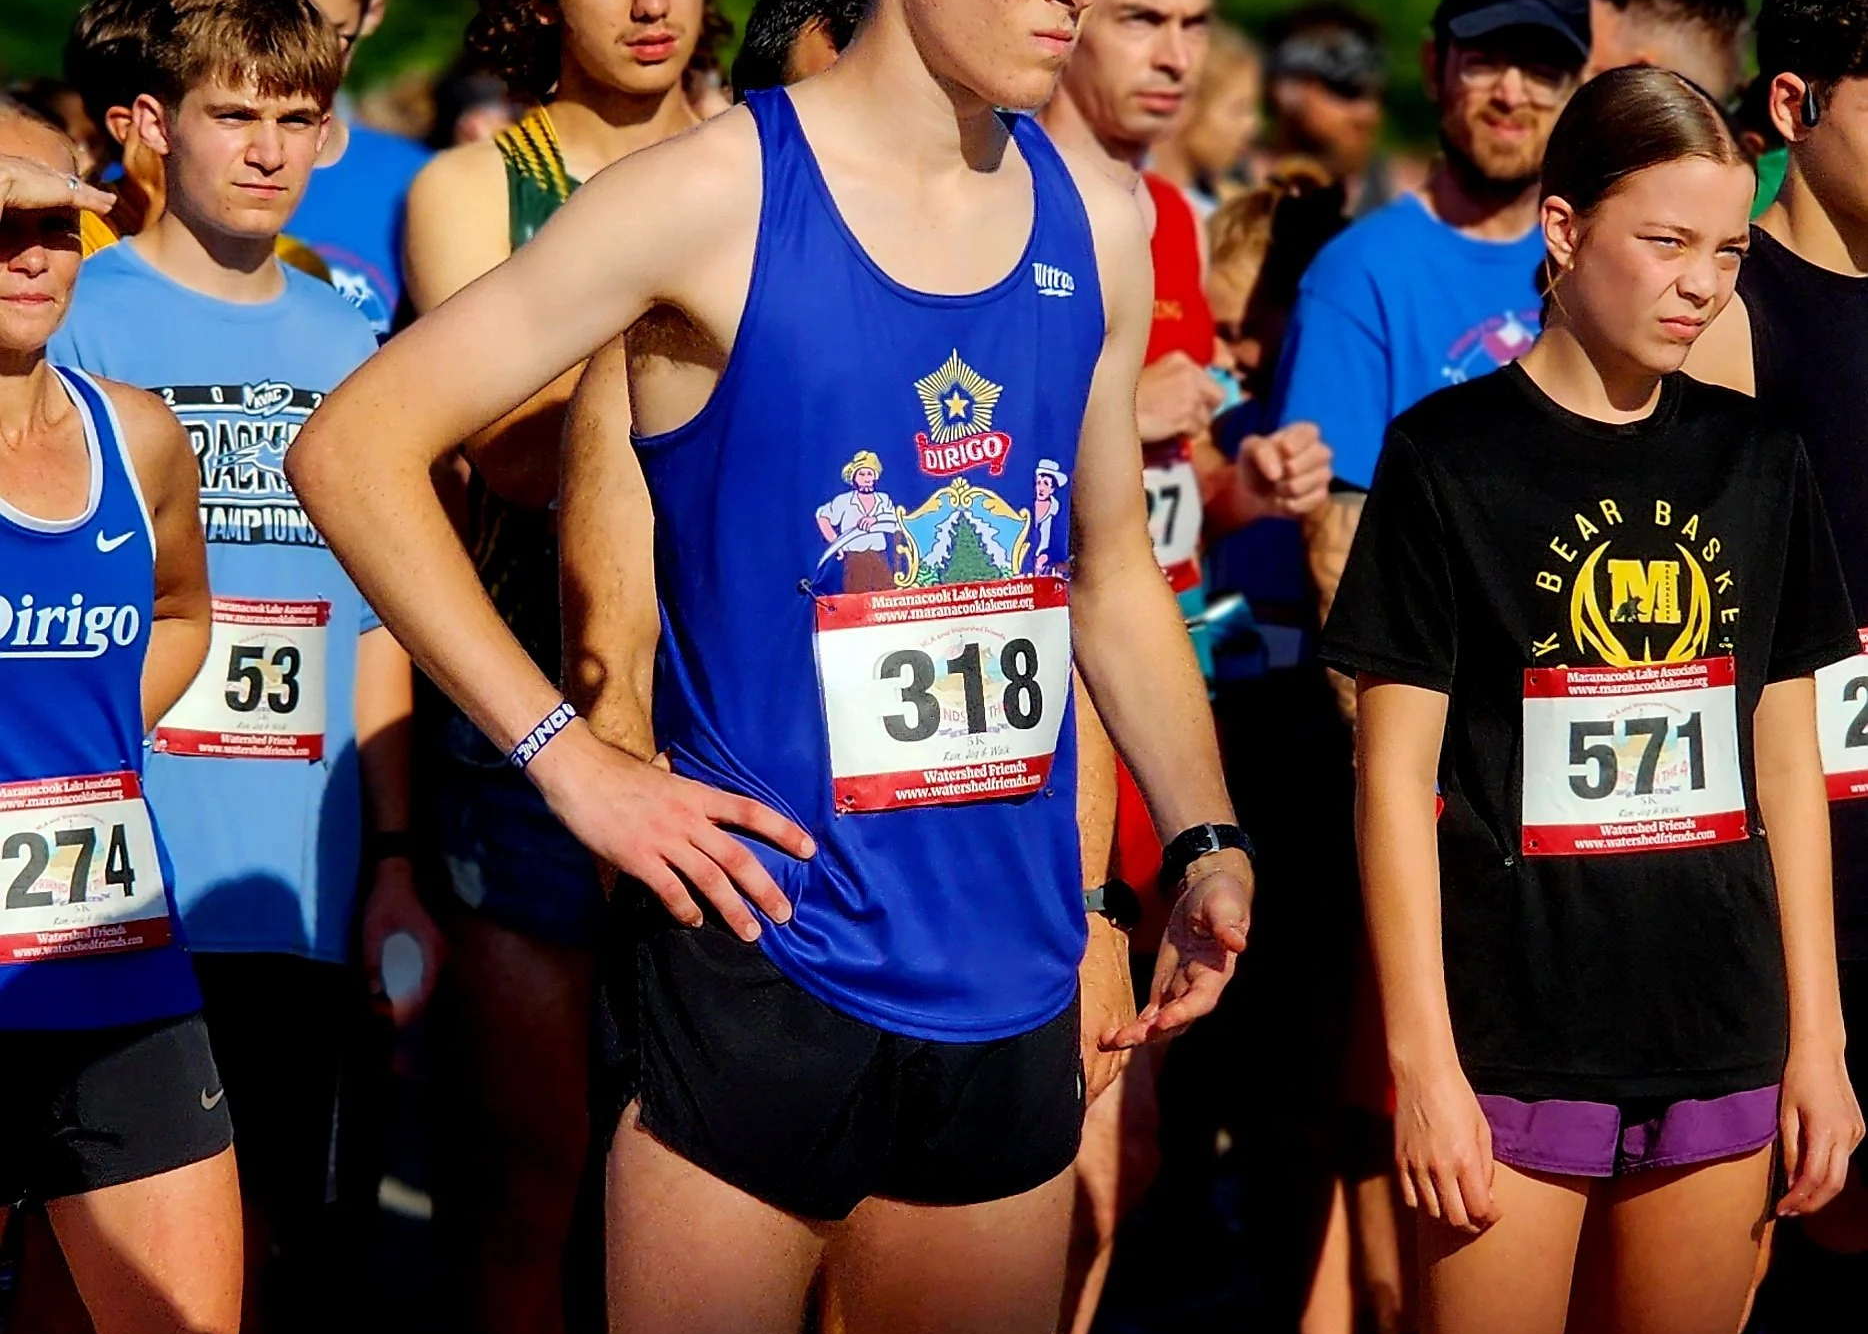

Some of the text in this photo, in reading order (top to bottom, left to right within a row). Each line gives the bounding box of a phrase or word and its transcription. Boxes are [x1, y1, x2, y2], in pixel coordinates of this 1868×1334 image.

[210, 386, 224, 403] 0
[924, 435, 1003, 470] DIRIGO
[1535, 498, 1624, 593] BEAR
[872, 581, 1034, 609] Maranacook Lake Association
[873, 597, 1035, 623] www.maranacooklakeme.org
[224, 644, 301, 714] 53
[1636, 668, 1660, 680] Lake
[879, 637, 1043, 743] 318
[1567, 710, 1707, 800] 571
[923, 759, 1027, 784] Watershed Friends
[895, 774, 1041, 801] www.watershedfriends.com
[1574, 829, 1717, 849] www.watershedfriends.com
[1600, 817, 1697, 836] Watershed Friends
[2, 824, 136, 910] 274
[37, 924, 127, 945] Watershed Friends
